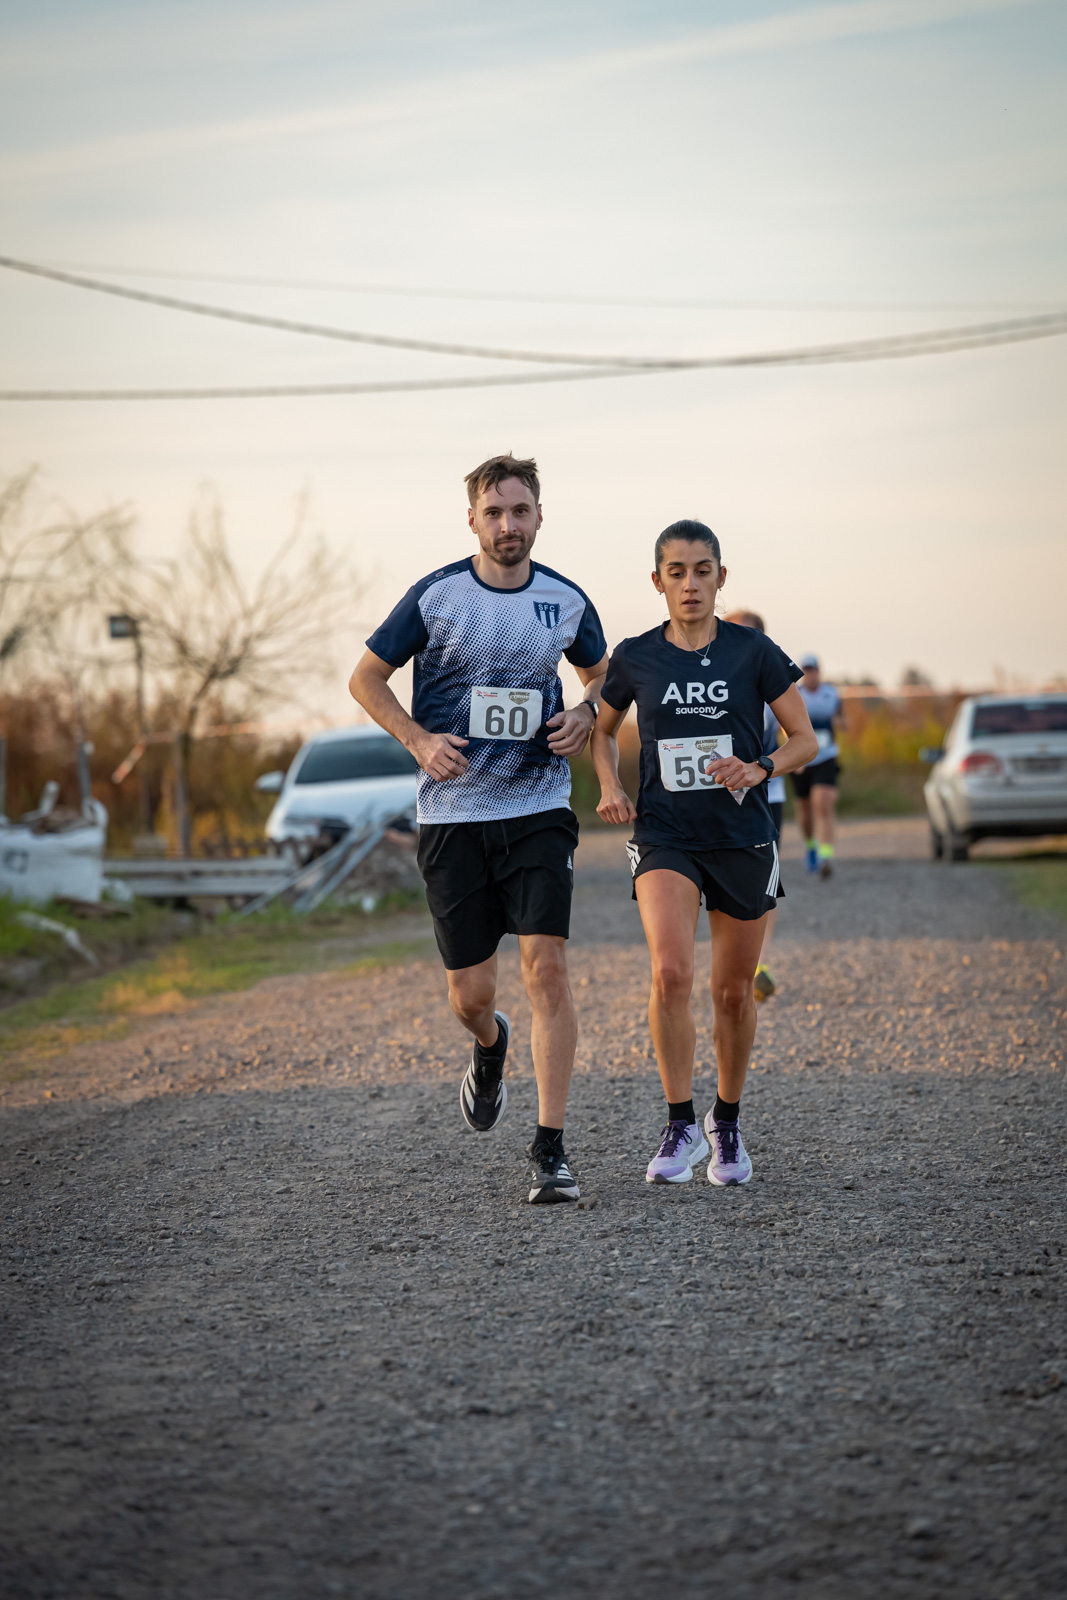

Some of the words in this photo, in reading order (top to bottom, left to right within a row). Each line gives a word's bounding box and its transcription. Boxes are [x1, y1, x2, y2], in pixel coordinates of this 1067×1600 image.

[538, 603, 556, 612] SFC
[661, 680, 729, 704] ARG
[675, 706, 717, 715] saucony
[485, 705, 529, 737] 60
